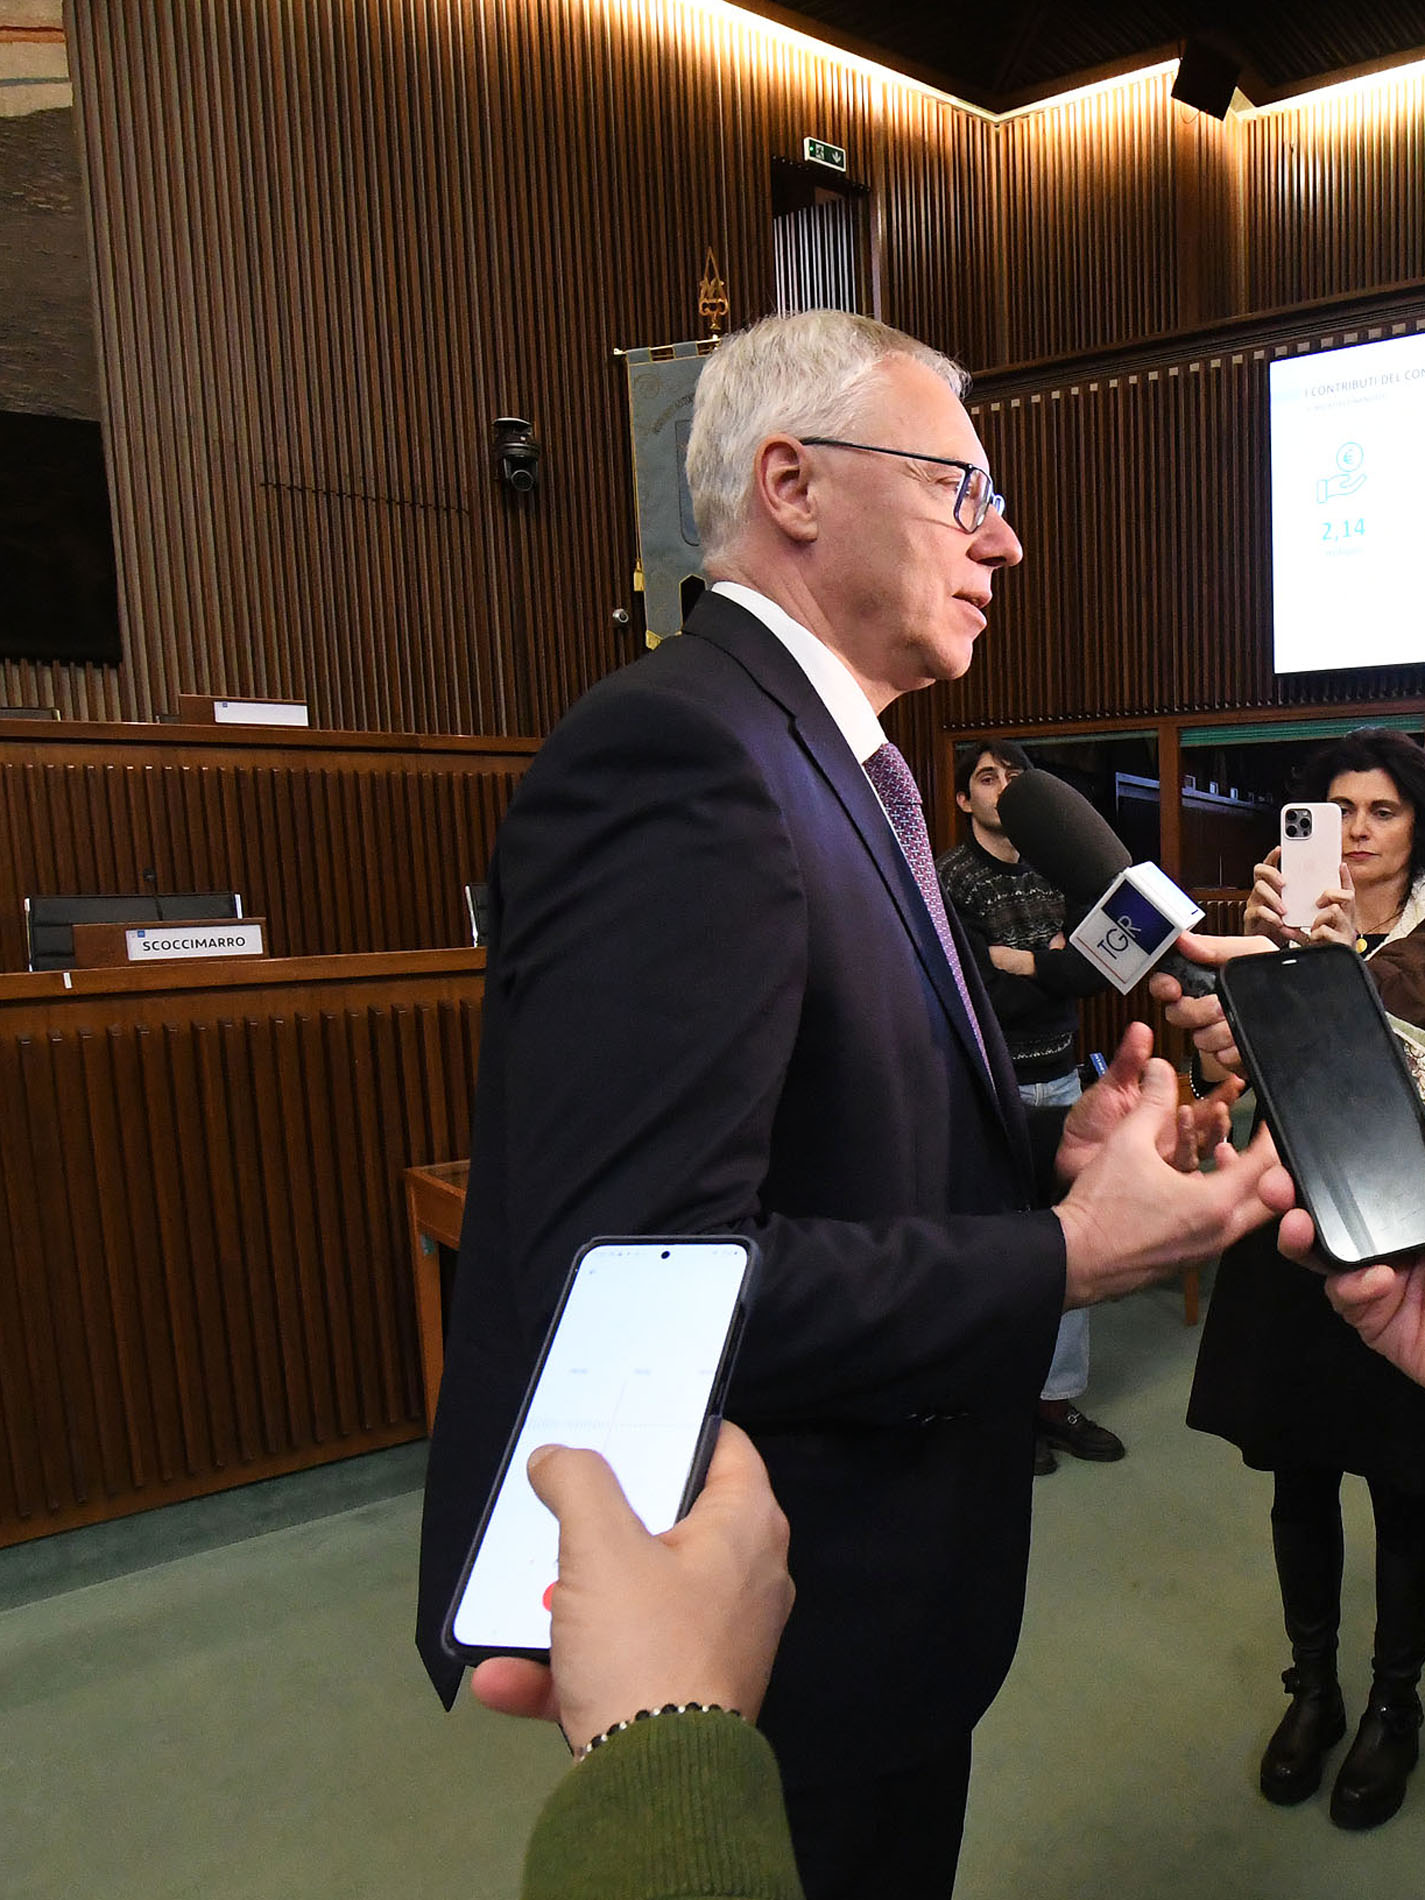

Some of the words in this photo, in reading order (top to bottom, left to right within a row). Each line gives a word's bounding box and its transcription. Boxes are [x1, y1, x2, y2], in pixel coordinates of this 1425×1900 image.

[1311, 376, 1378, 397] CONTRIBUTI
[1381, 371, 1401, 385] DEL
[1322, 517, 1366, 542] 2,14
[142, 936, 246, 952] SCOCCIMARRO
[1097, 915, 1142, 960] TGR
